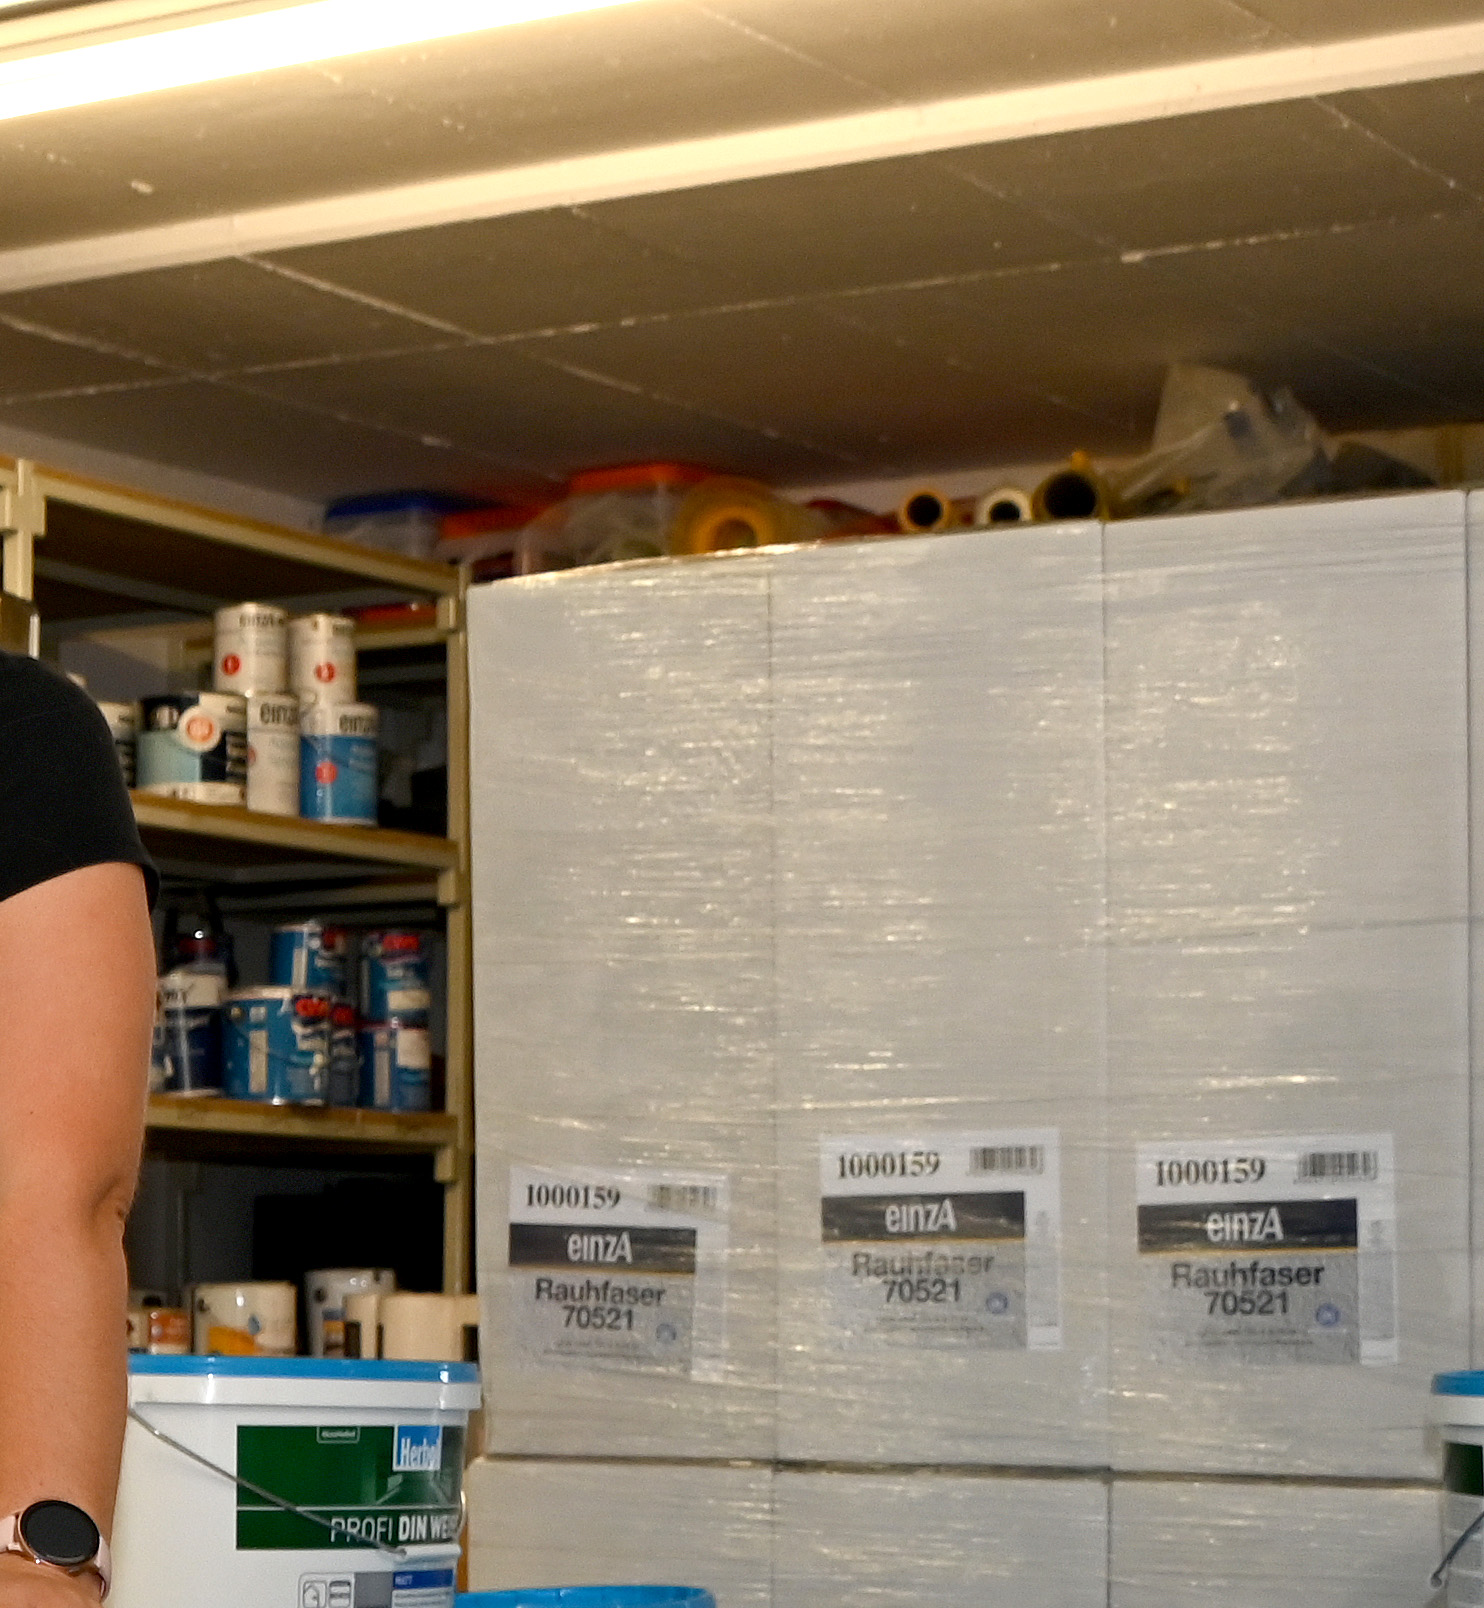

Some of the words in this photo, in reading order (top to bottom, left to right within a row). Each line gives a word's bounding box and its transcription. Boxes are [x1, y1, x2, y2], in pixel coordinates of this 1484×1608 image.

[836, 1150, 941, 1179] 1000159
[1155, 1157, 1267, 1187] 1000159
[524, 1182, 621, 1211] 1000159
[885, 1200, 956, 1233] einzA
[1206, 1206, 1285, 1243] einzA
[566, 1229, 632, 1265] einzA
[1170, 1260, 1325, 1289] Rauhfaser
[535, 1276, 667, 1307] Rauhfaser
[882, 1278, 961, 1304] 70521
[1205, 1289, 1290, 1317] 70521
[563, 1304, 633, 1330] 70521
[330, 1517, 393, 1542] PROFI
[399, 1514, 427, 1541] DIN
